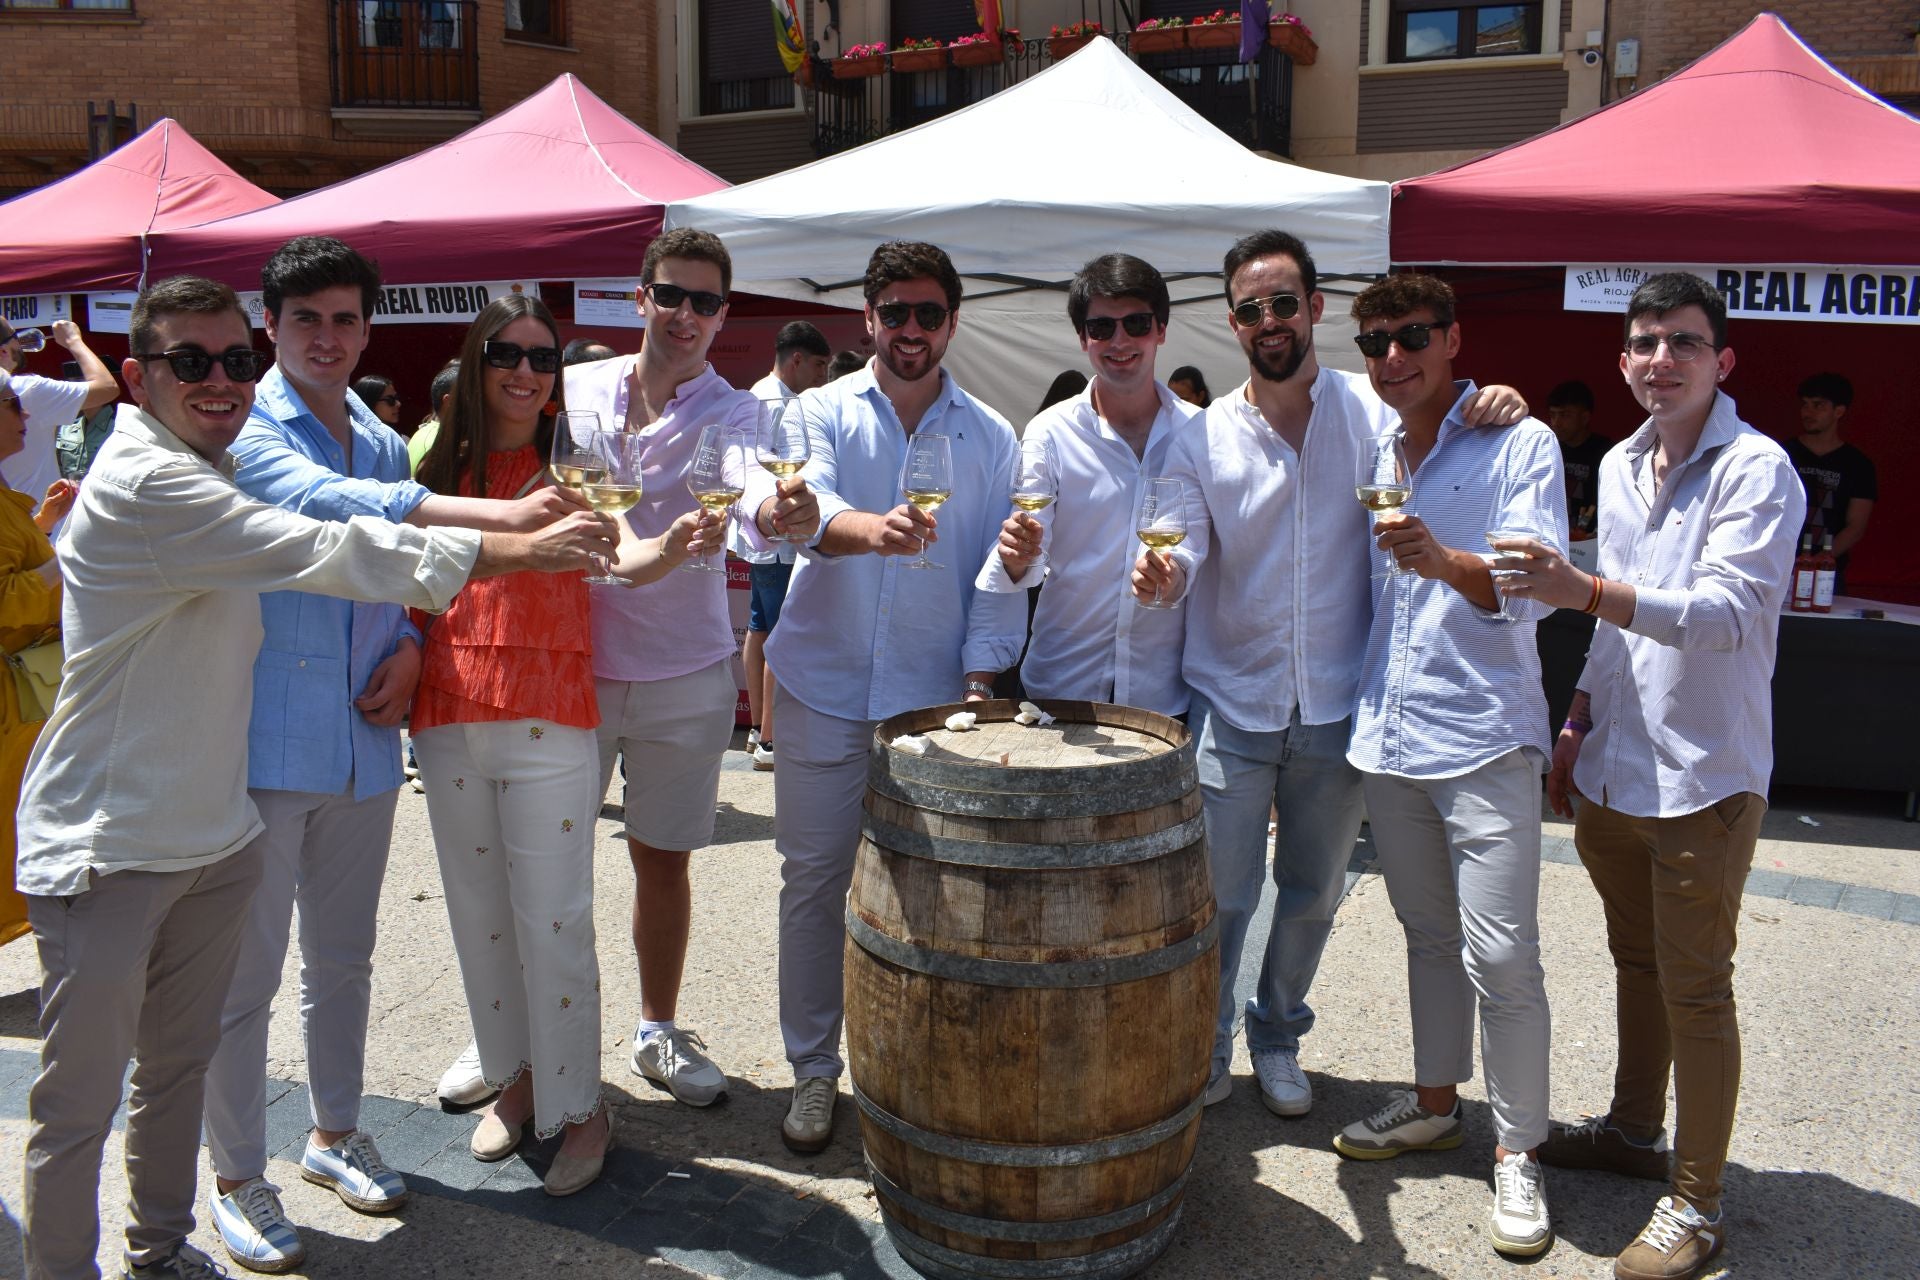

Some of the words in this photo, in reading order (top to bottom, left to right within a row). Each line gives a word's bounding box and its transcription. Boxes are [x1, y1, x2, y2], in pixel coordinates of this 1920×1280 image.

[1576, 268, 1610, 289] REAL
[1717, 269, 1811, 313] REAL
[375, 287, 423, 315] REAL
[424, 285, 490, 314] RUBIO
[1604, 288, 1637, 296] RIOJA
